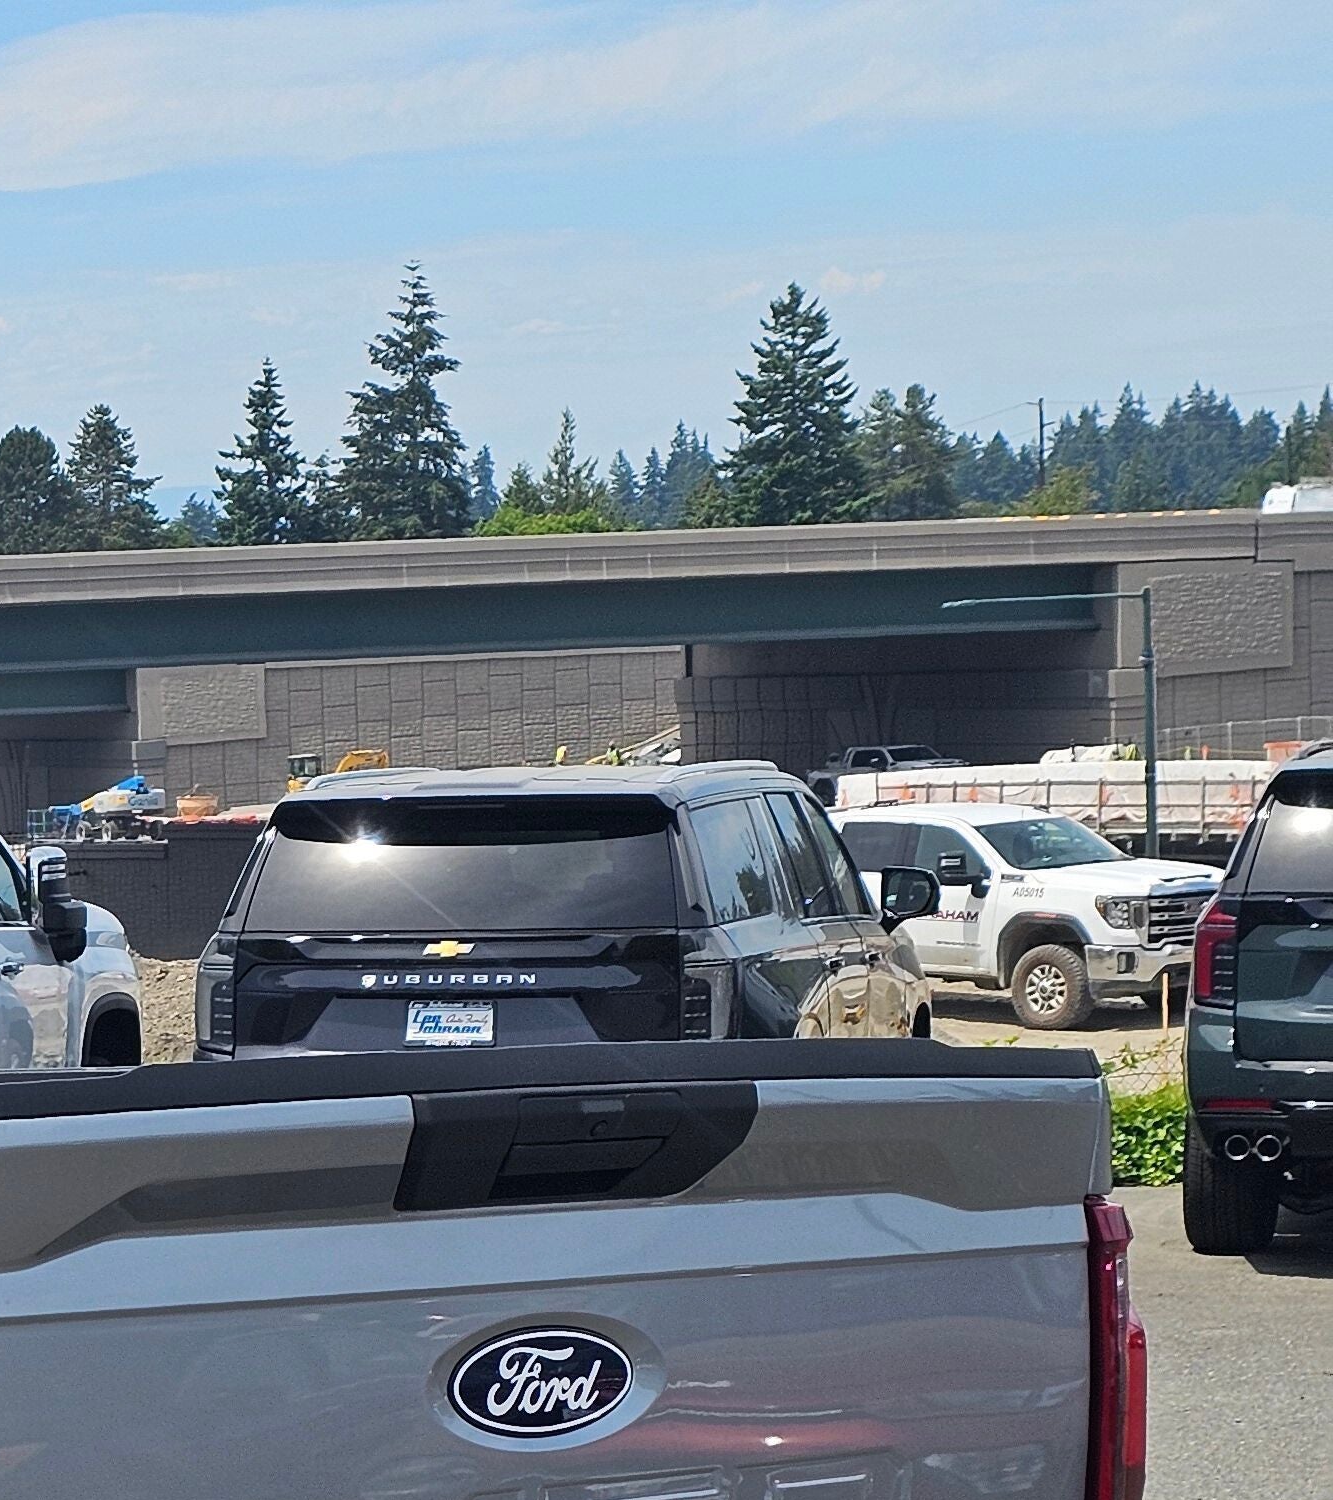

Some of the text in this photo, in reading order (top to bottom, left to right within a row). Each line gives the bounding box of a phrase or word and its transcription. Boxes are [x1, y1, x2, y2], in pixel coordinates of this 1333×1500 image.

[1012, 887, 1044, 898] A05015
[361, 974, 536, 988] SUBURBAN
[487, 1346, 602, 1417] Ford
